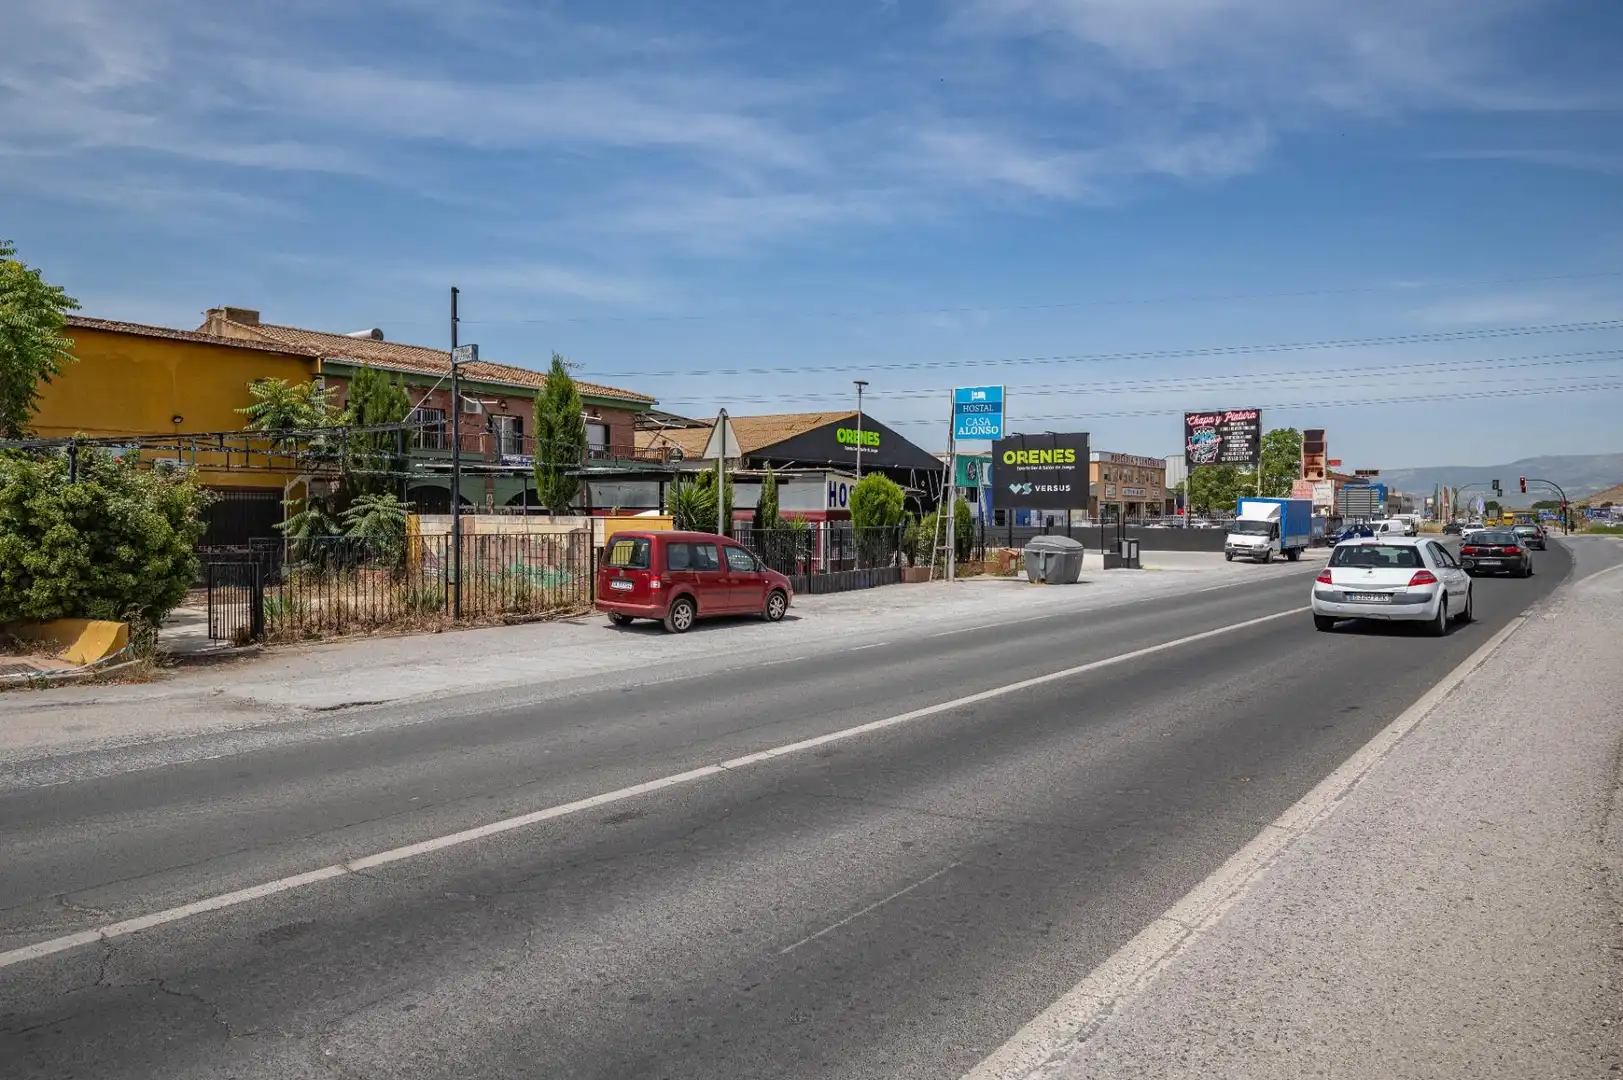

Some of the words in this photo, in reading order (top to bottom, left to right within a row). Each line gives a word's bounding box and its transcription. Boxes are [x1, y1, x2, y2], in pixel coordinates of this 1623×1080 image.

[963, 404, 994, 412] HOSTAL
[965, 417, 991, 426] CASA
[1186, 415, 1215, 426] Chapa
[1215, 416, 1222, 425] y
[1224, 411, 1257, 422] Pintura
[958, 426, 999, 435] ALONSO
[836, 428, 880, 446] ORENES
[1003, 449, 1076, 465] ORENES
